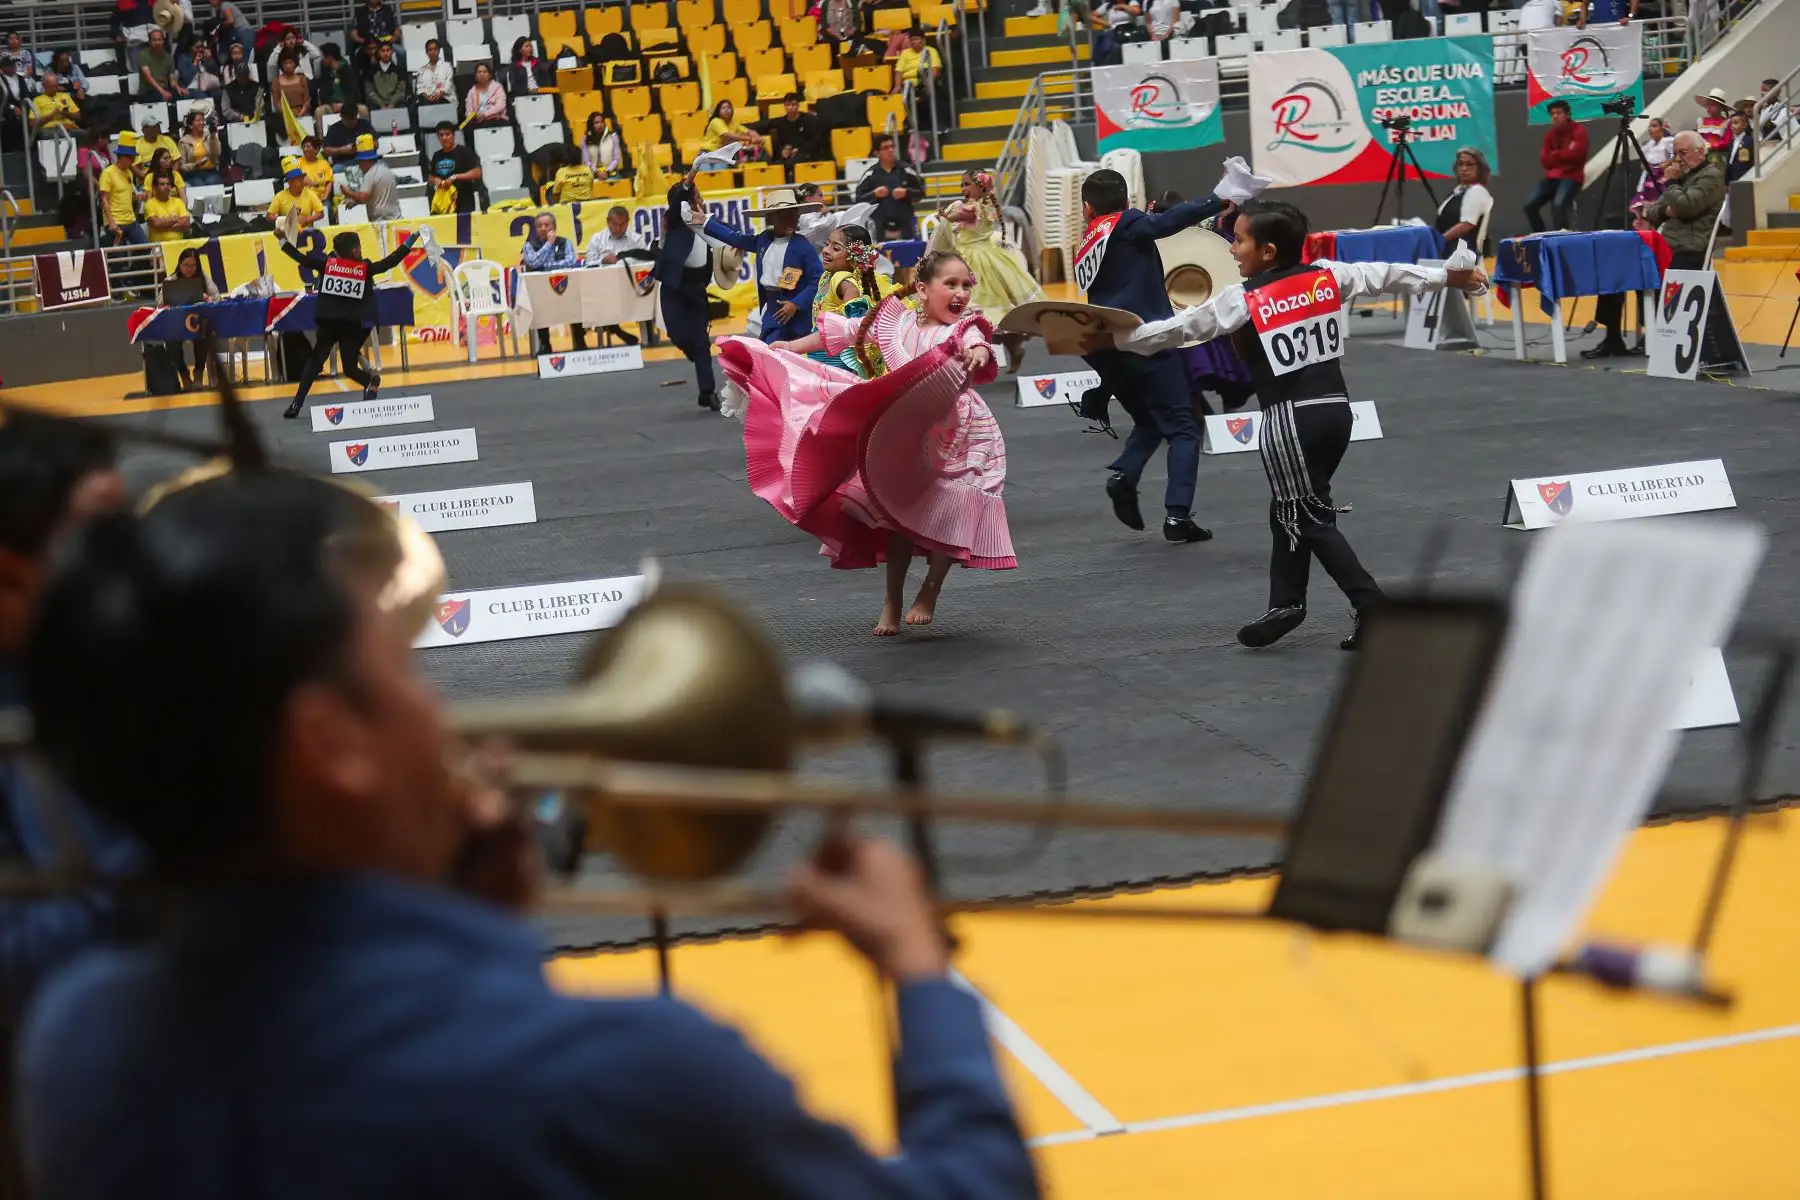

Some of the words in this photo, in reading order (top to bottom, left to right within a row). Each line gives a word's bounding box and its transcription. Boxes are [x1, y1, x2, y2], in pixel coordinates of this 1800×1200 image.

[1403, 65, 1442, 83] QUE
[1444, 62, 1484, 80] UNA
[1371, 104, 1433, 124] SOMOS
[1434, 102, 1472, 120] UNA
[60, 287, 90, 301] PISTA
[325, 278, 361, 297] 0334
[1258, 276, 1334, 325] plazavea
[1675, 285, 1706, 374] 3
[1271, 317, 1340, 367] 0319
[352, 406, 375, 416] CLUB
[377, 402, 420, 413] LIBERTAD
[379, 444, 407, 453] CLUB
[409, 438, 460, 450] LIBERTAD
[401, 449, 440, 458] TRUJILLO
[1587, 482, 1628, 496] CLUB
[1631, 475, 1705, 492] LIBERTAD
[413, 502, 447, 514] CLUB
[451, 495, 514, 510] LIBERTAD
[1621, 490, 1678, 503] TRUJILLO
[440, 508, 489, 519] TRUJILLO
[488, 599, 535, 615] CLUB
[539, 590, 623, 609] LIBERTAD
[526, 607, 590, 622] TRUJILLO
